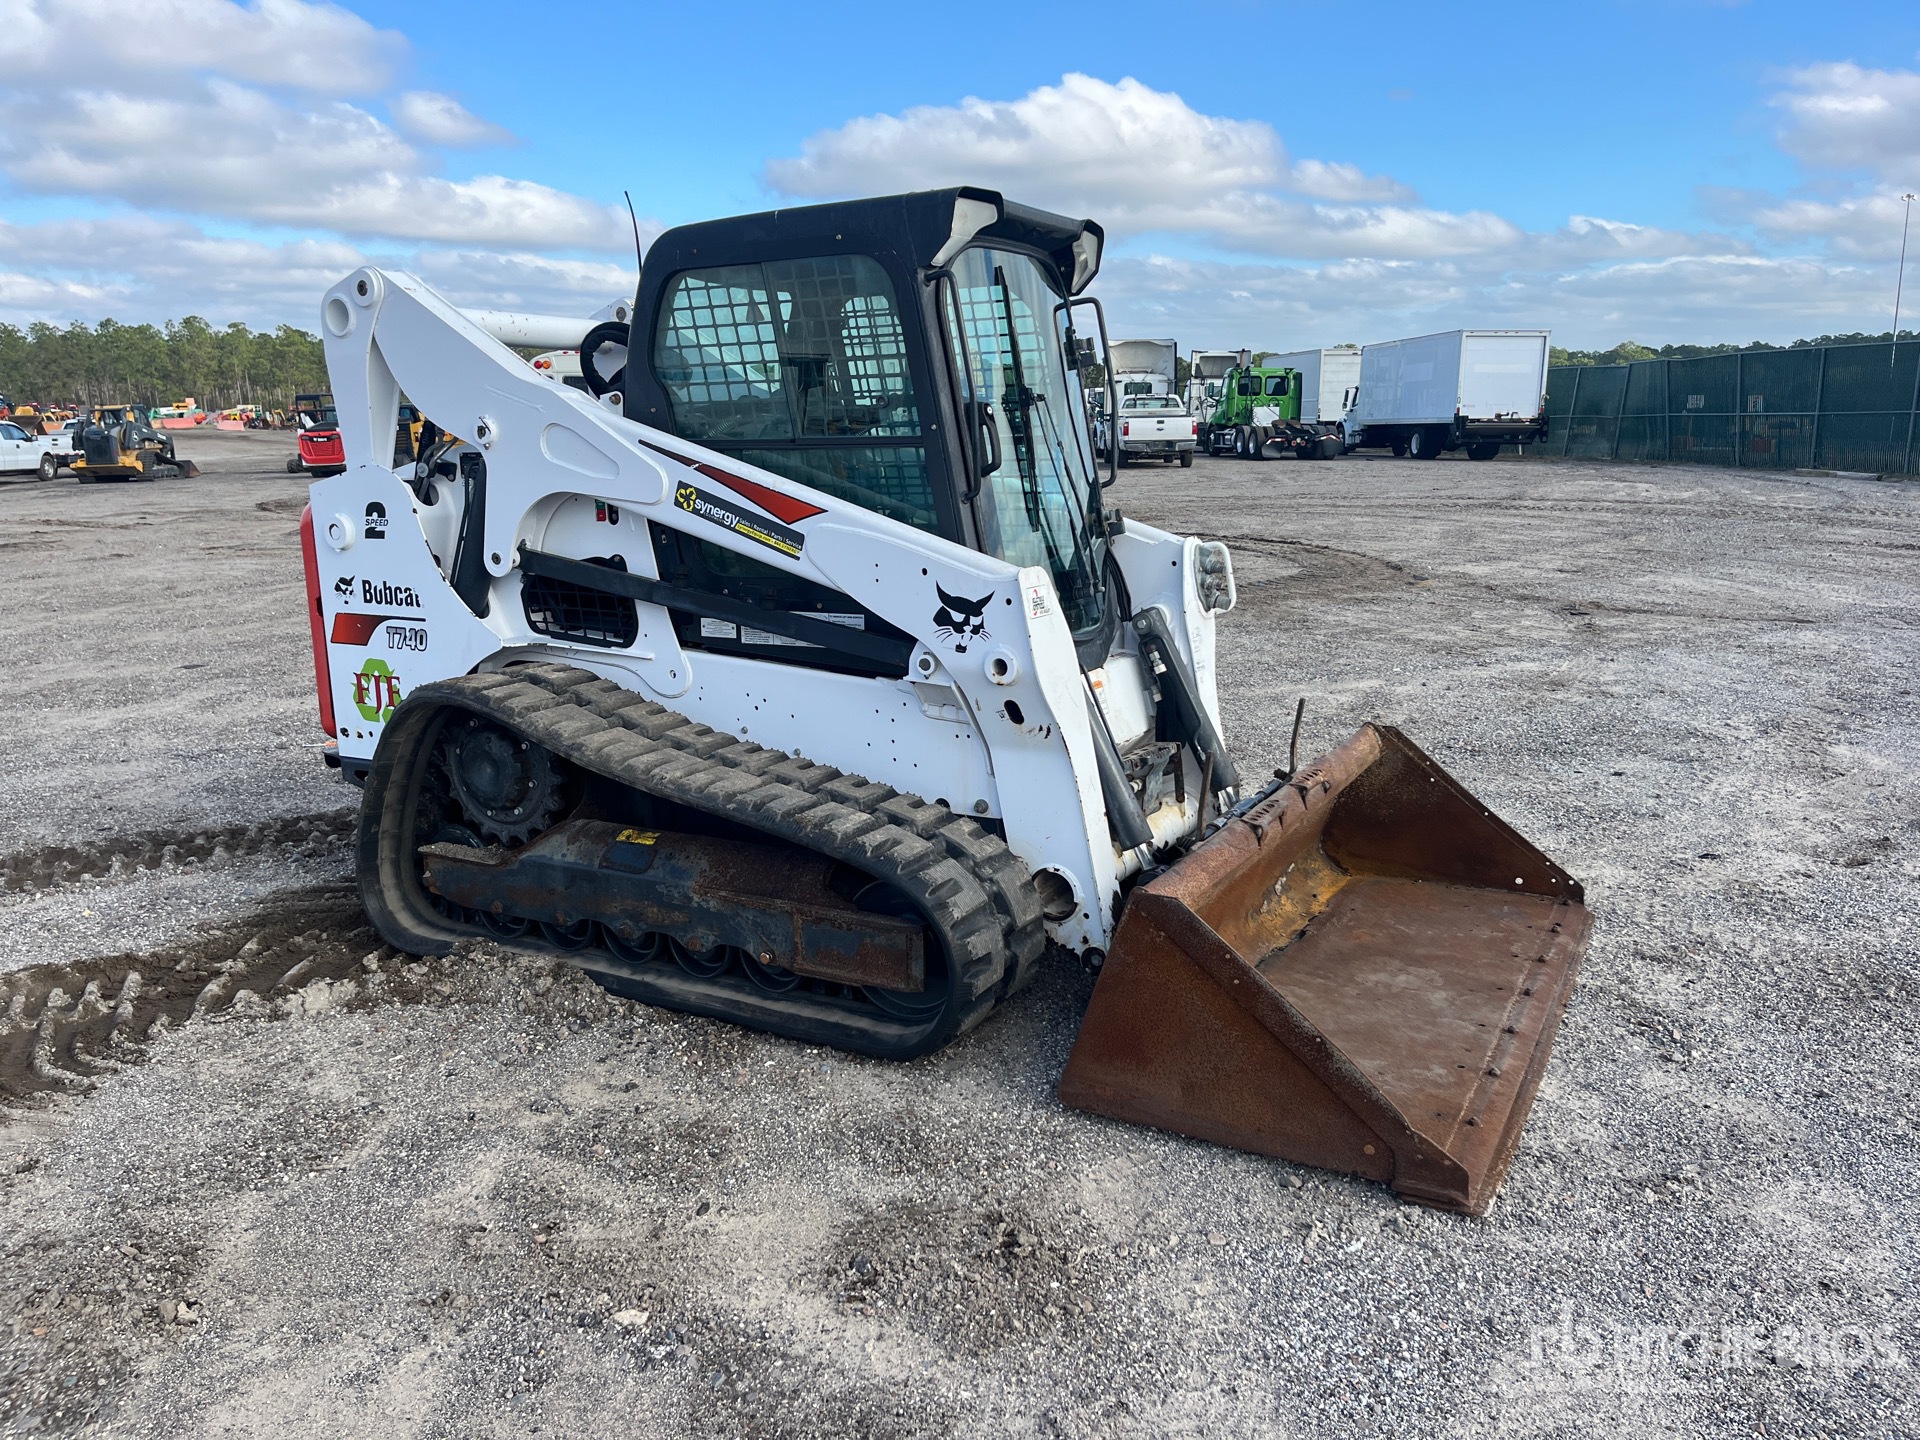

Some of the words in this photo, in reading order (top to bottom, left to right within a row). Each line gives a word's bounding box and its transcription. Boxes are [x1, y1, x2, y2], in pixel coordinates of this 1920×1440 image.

[365, 518, 388, 527] SPEED
[694, 498, 739, 528] synergy
[739, 517, 751, 528] Sales
[753, 523, 769, 535] Rental
[771, 531, 783, 542] Parts
[785, 538, 802, 549] Service
[361, 579, 421, 608] Bobcat
[386, 625, 427, 651] T740
[353, 672, 401, 714] FJF
